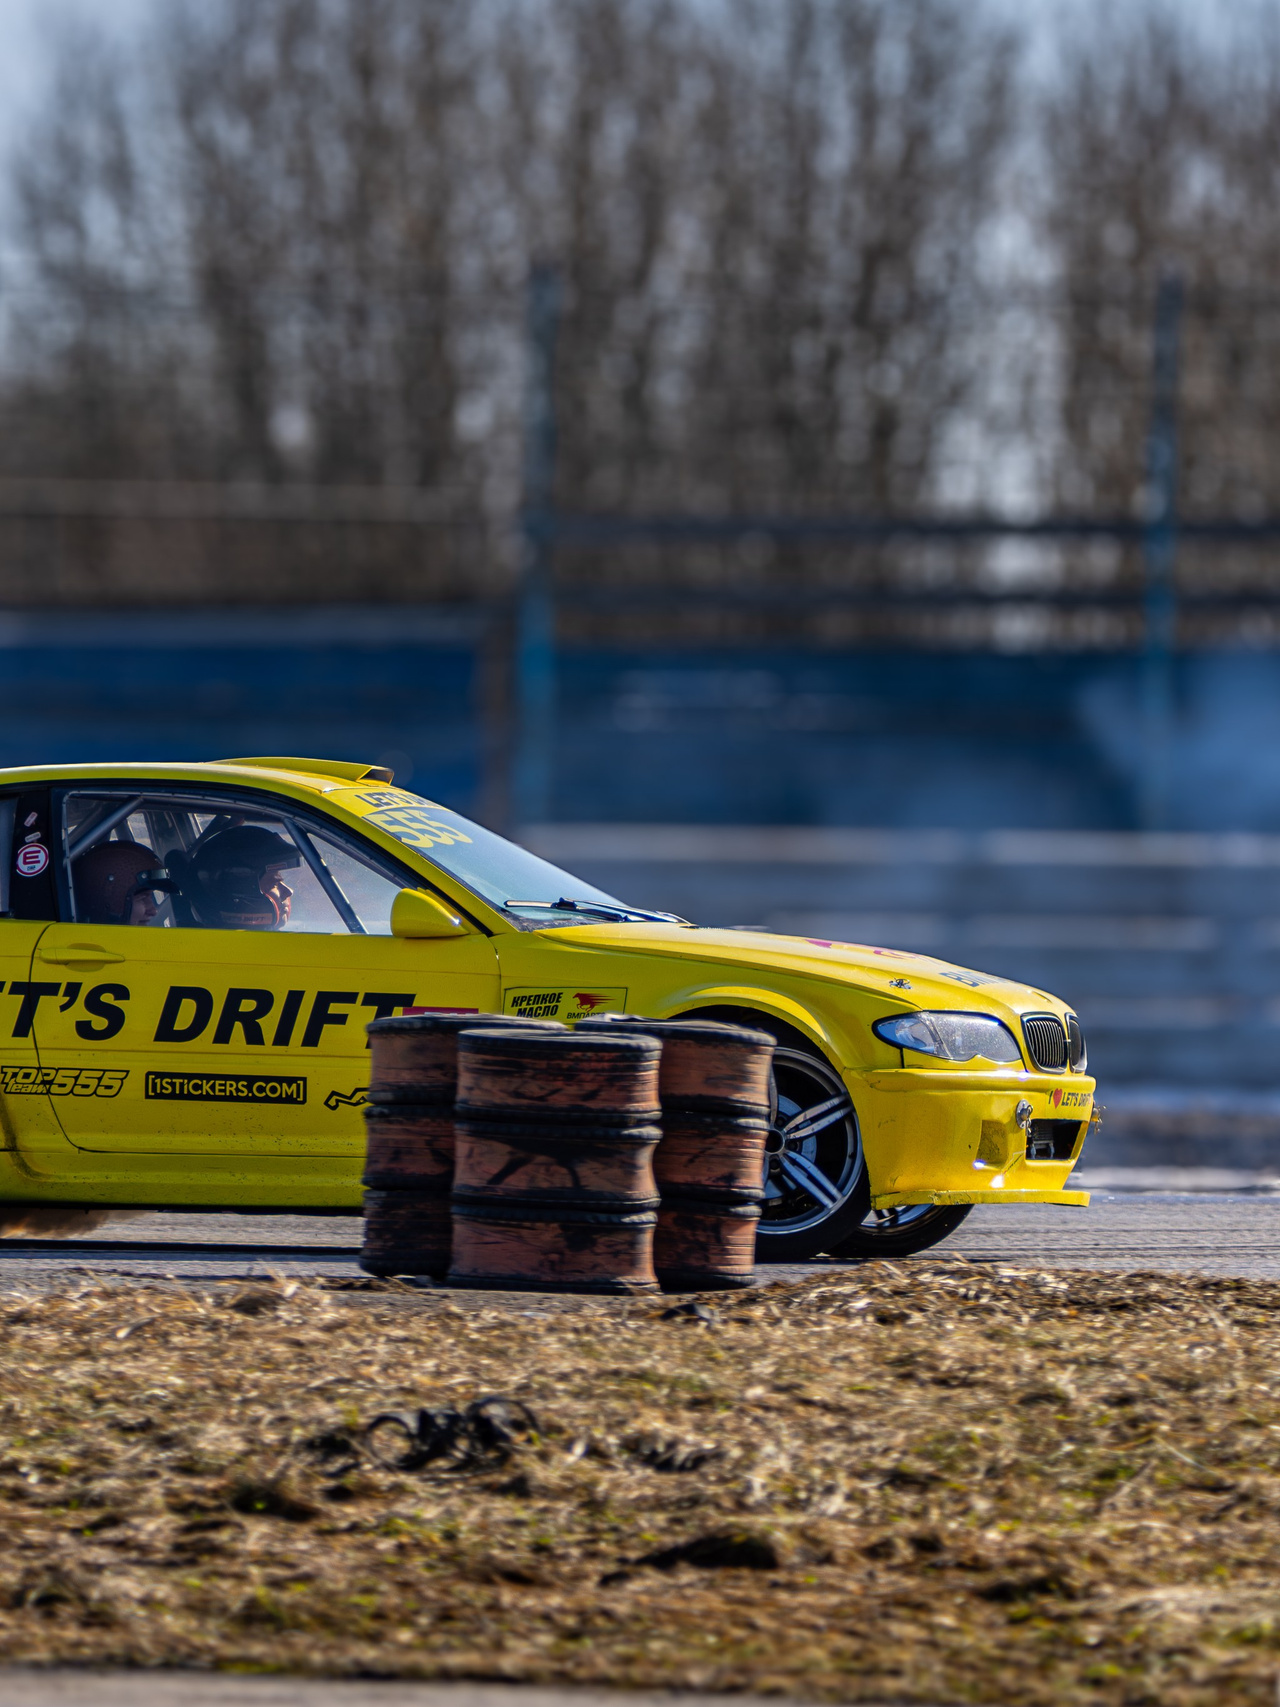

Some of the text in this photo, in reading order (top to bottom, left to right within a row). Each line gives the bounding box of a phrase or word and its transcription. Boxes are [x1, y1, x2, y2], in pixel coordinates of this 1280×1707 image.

[363, 809, 473, 848] 555
[22, 850, 41, 865] E
[511, 992, 564, 1008] КРЕПКОЕ
[153, 985, 417, 1049] DRIFT
[516, 1005, 559, 1019] МАСЛО
